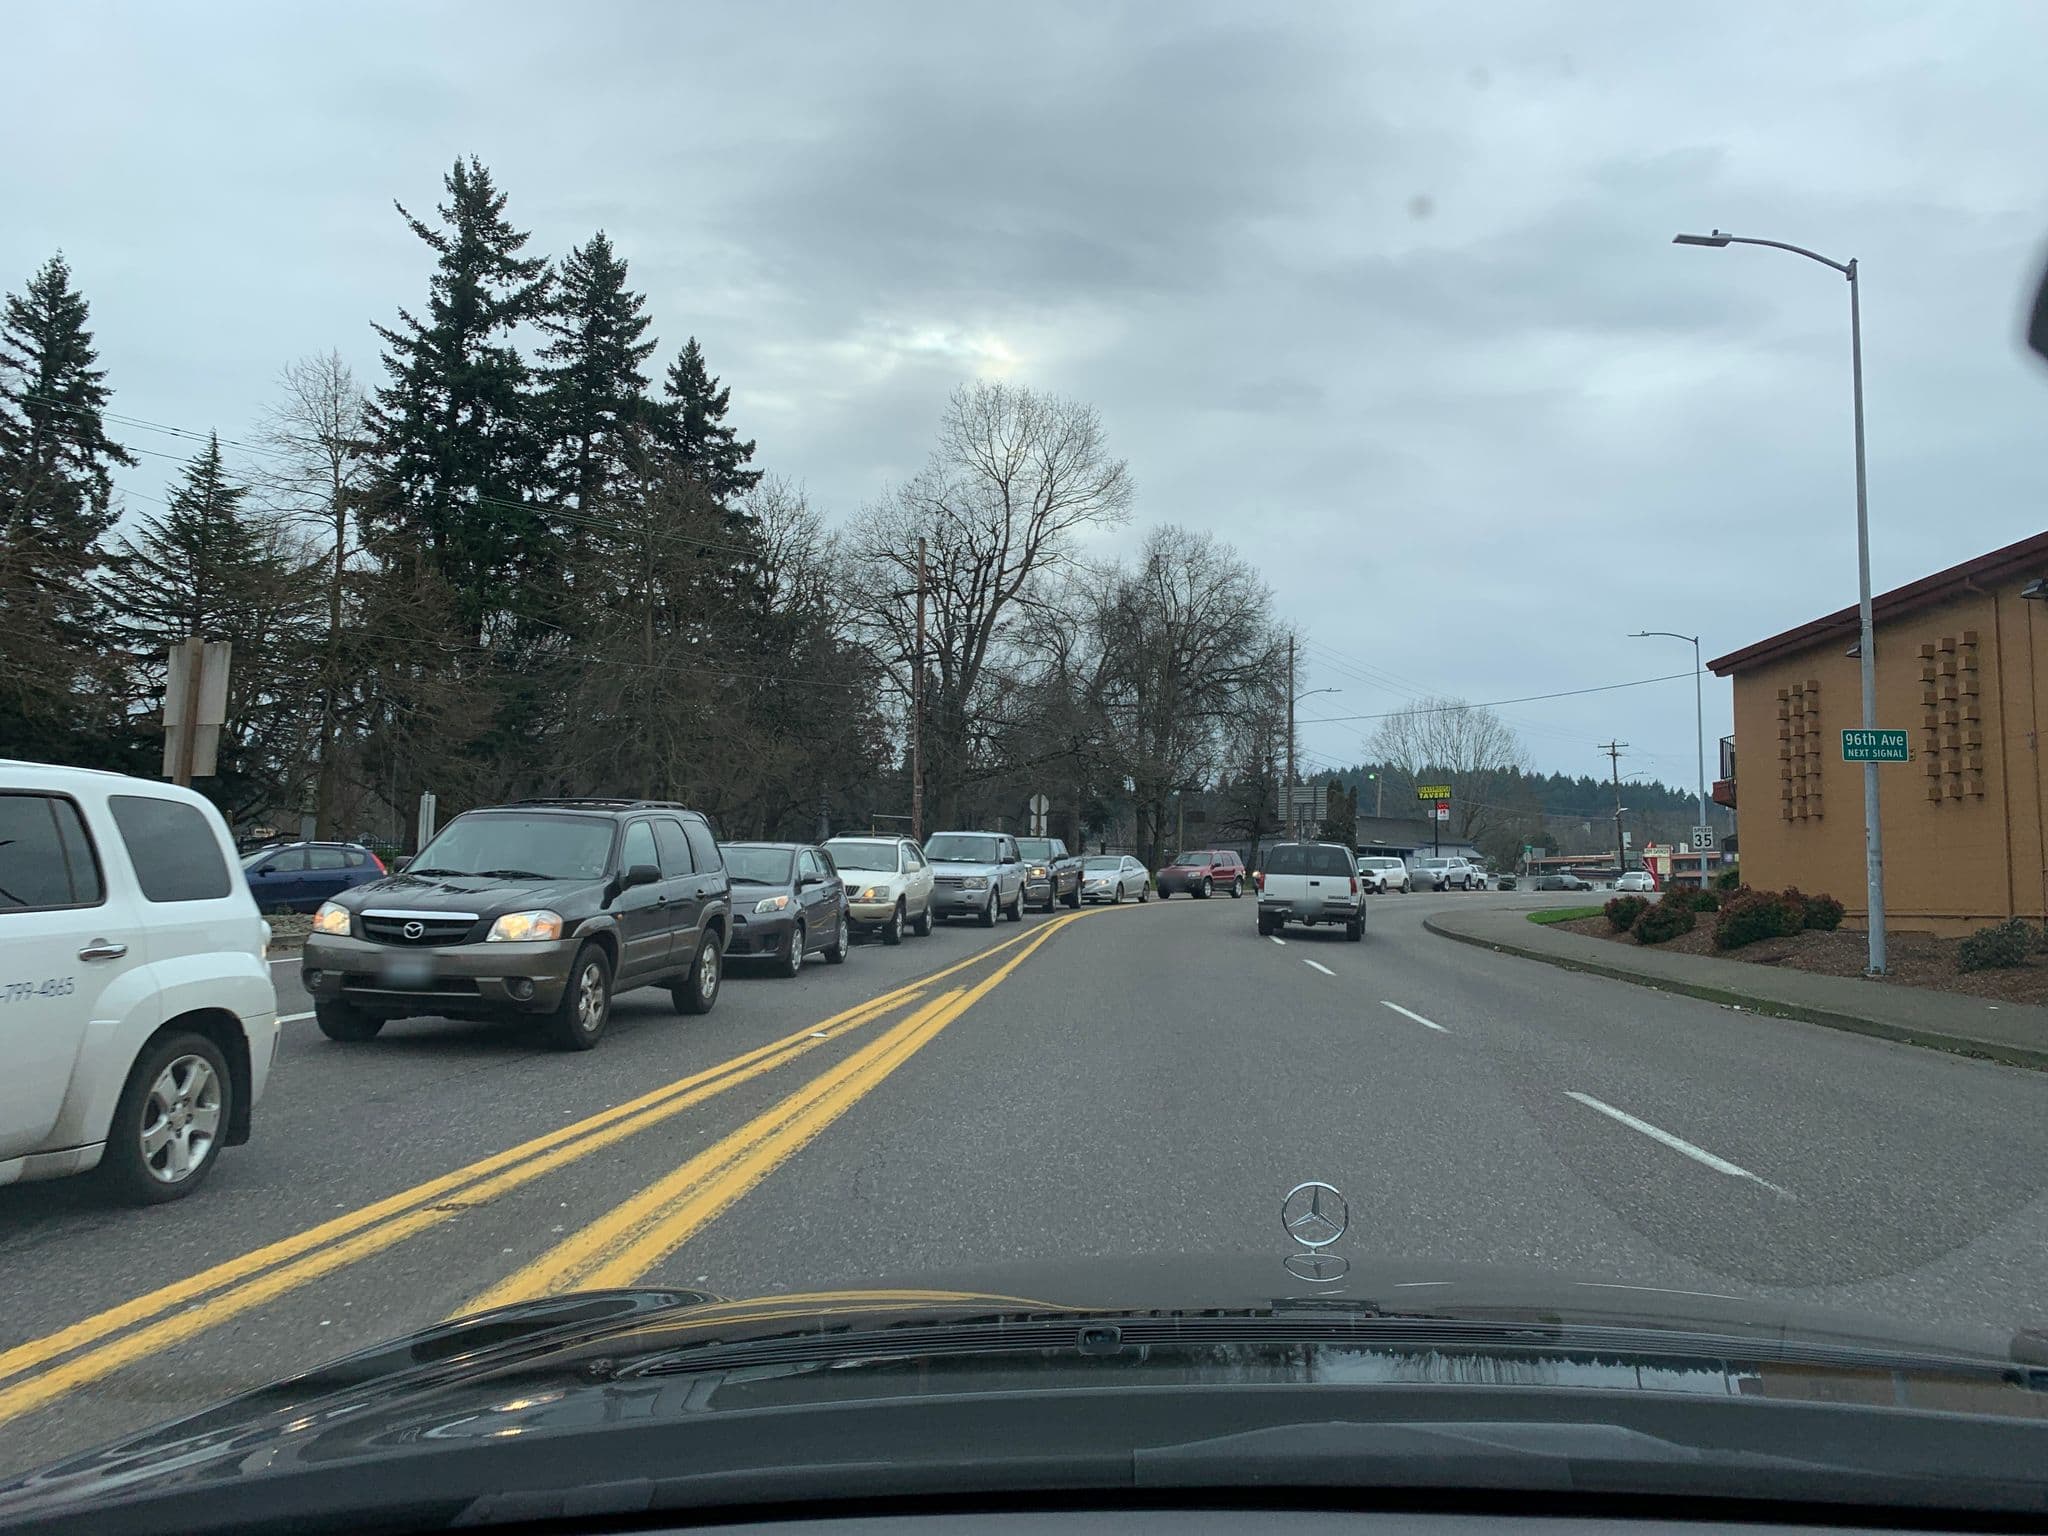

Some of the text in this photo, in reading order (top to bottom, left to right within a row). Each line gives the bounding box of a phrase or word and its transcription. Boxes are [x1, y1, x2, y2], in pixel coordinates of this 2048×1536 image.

[1845, 732, 1904, 746] 96th Ave
[1848, 749, 1904, 758] NEXT SIGNAL
[1695, 834, 1712, 847] 35
